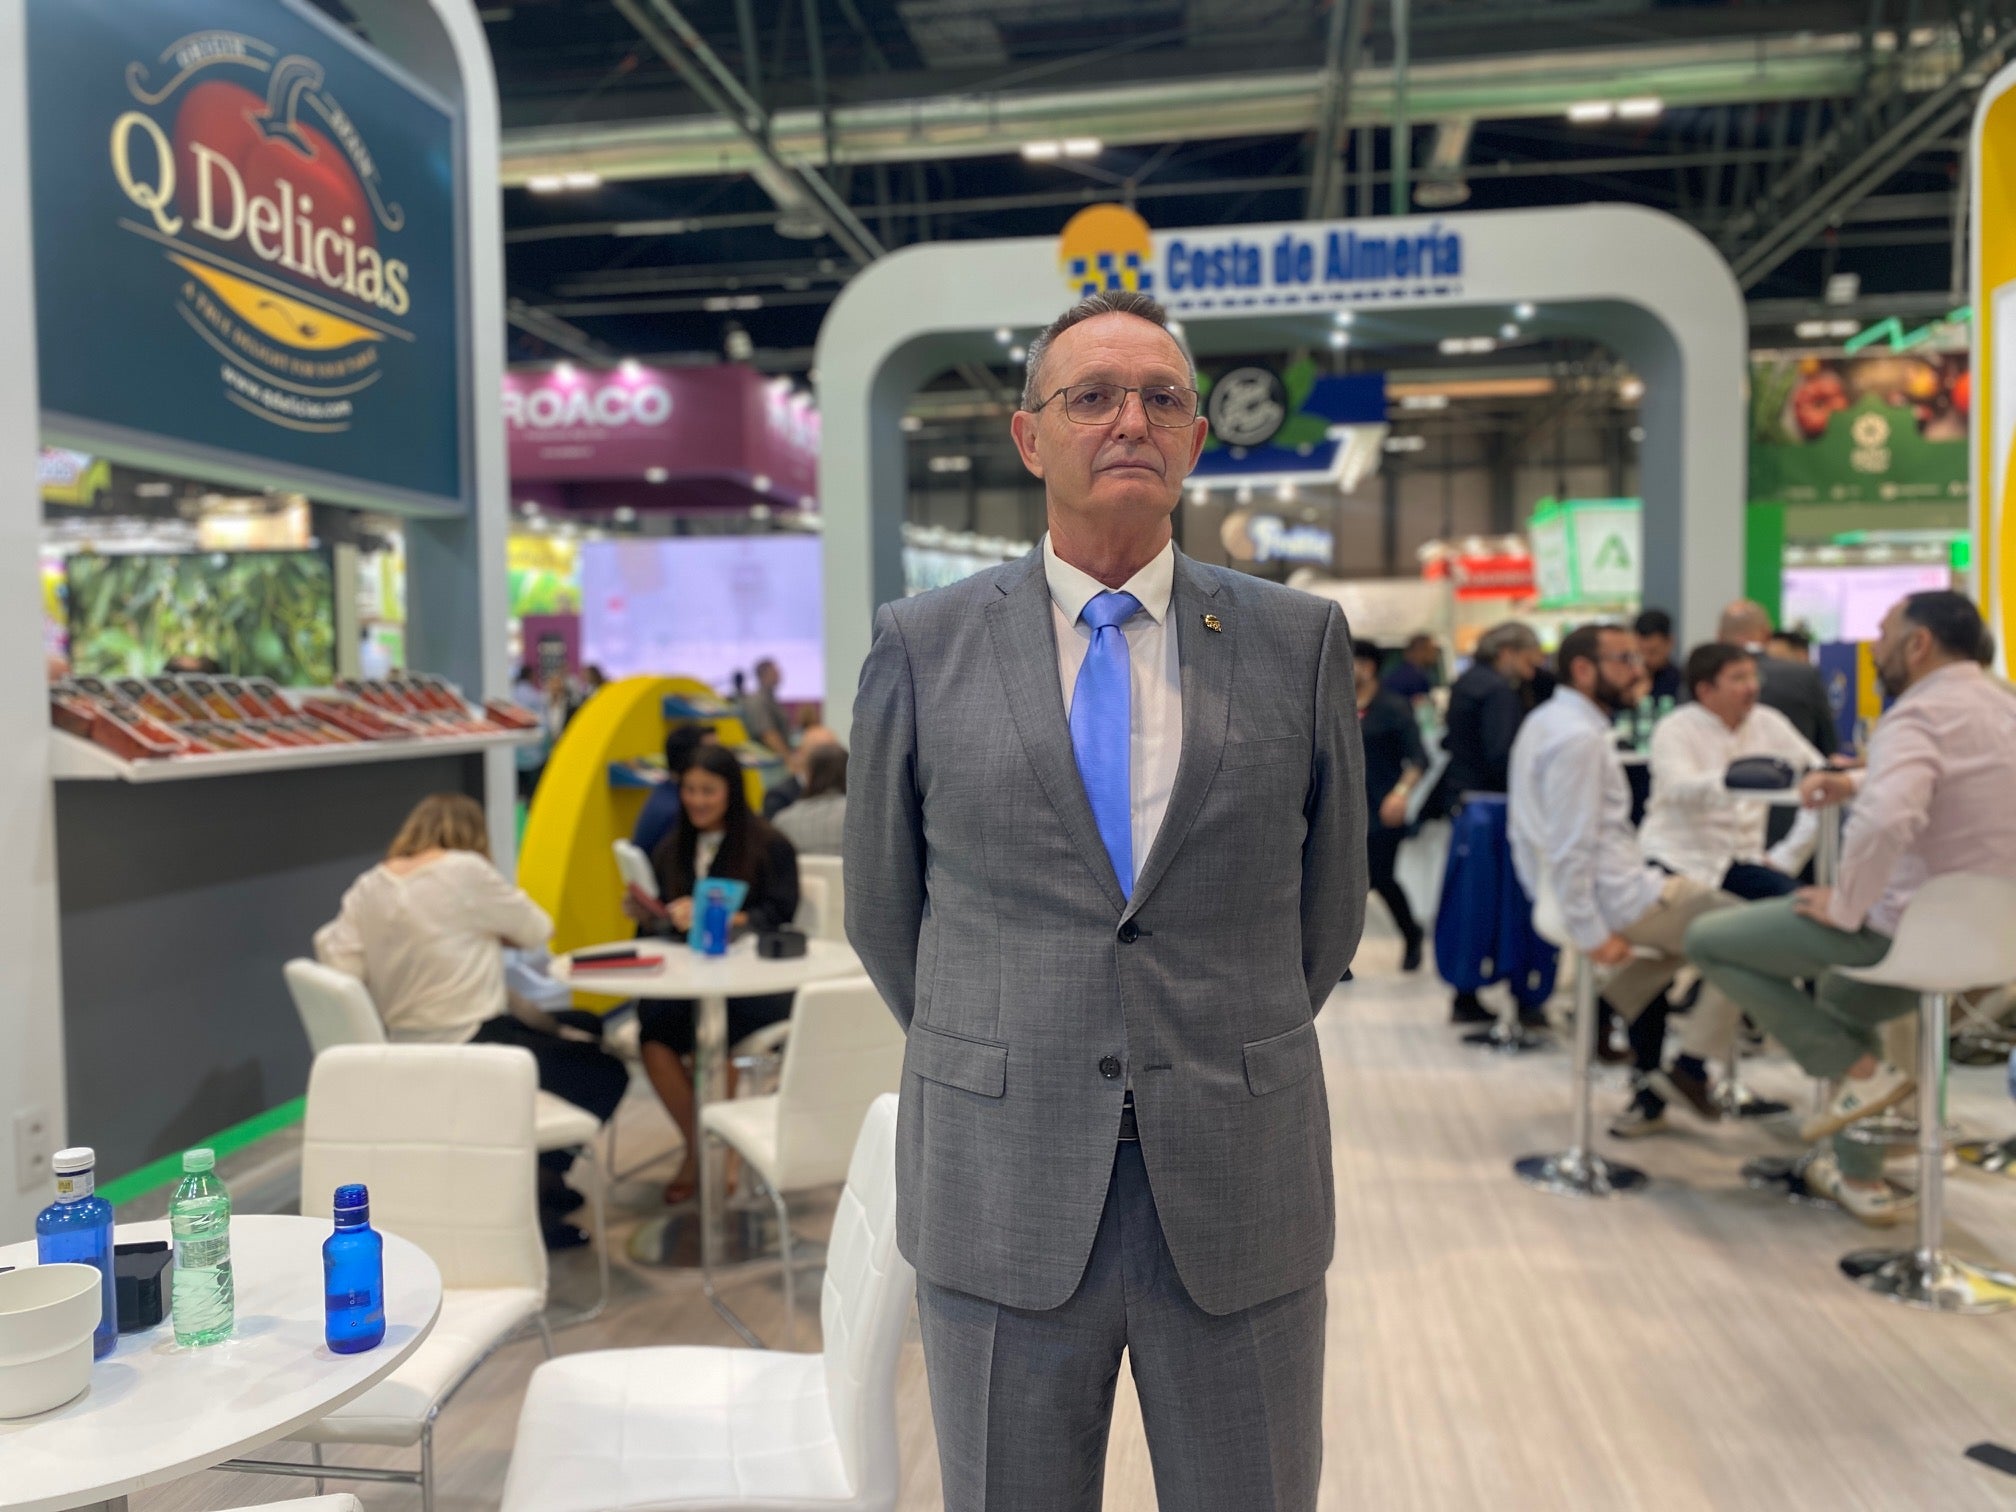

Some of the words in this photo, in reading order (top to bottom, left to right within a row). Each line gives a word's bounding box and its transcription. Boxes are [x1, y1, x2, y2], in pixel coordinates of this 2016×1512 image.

[111, 111, 182, 236] Q
[189, 141, 410, 316] Delicias
[1168, 241, 1261, 291] Costa
[1274, 233, 1313, 284] de
[1326, 221, 1461, 281] Almería
